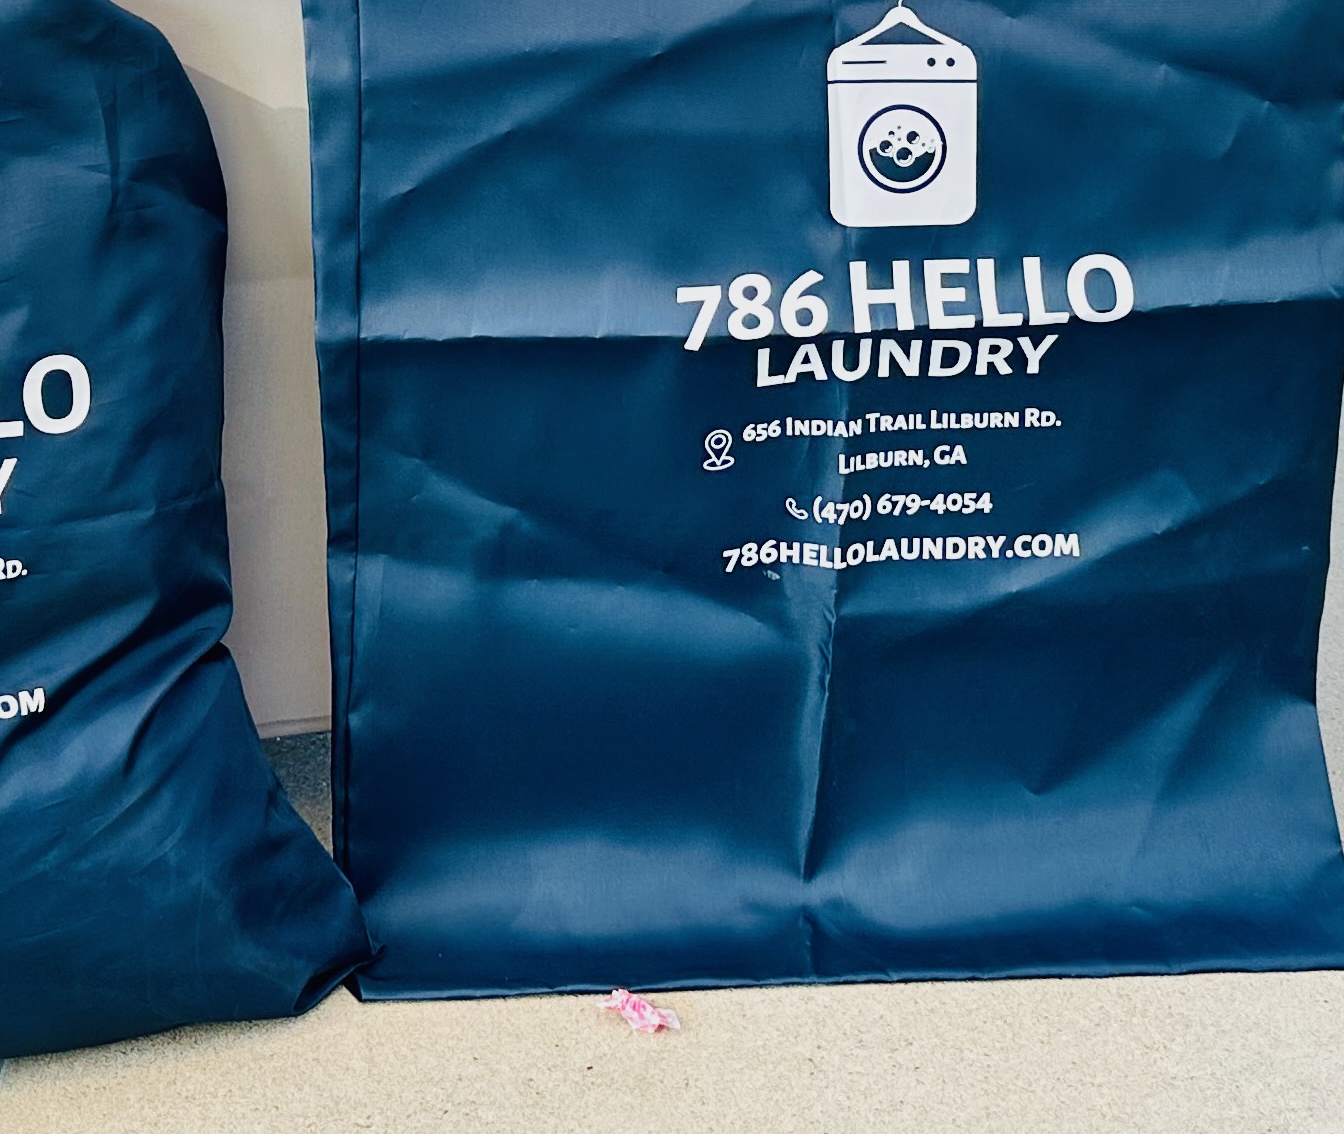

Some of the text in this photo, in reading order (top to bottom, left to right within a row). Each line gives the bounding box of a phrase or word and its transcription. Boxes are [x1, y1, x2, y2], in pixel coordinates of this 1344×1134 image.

[676, 253, 1135, 352] 786 HELLO
[756, 334, 1059, 388] LAUNDRY
[742, 408, 1062, 442] 656 INDIAN TRAIL LILBURN RD.
[838, 445, 967, 475] LILBURN, GA
[812, 492, 993, 525] (470) 679-4054
[722, 533, 1080, 573] 786HELLOLAUNDRY.COM
